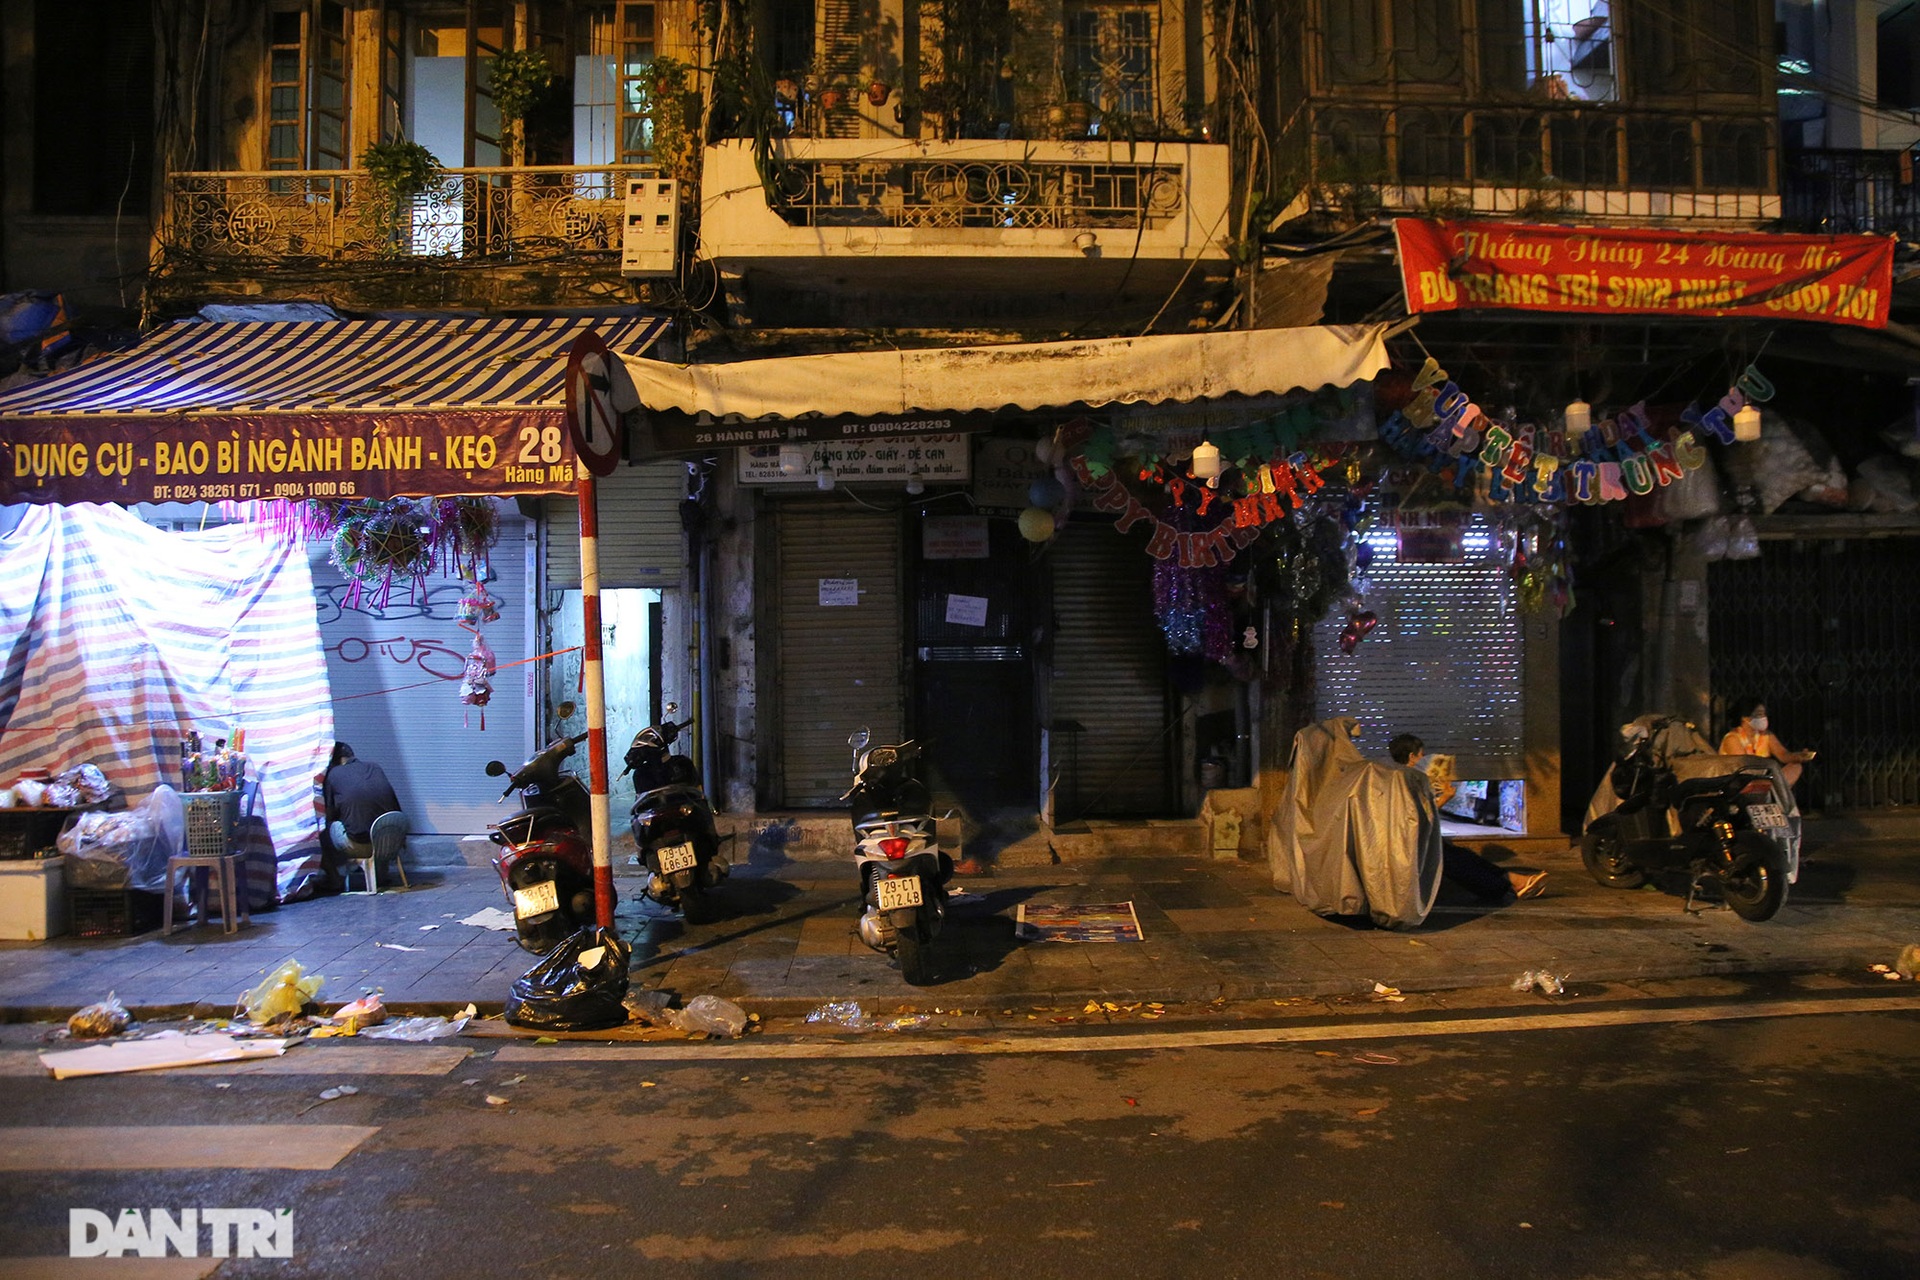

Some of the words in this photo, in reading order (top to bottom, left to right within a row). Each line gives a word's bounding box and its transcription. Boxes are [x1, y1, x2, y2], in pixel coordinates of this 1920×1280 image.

[1656, 242, 1689, 265] 24
[1703, 244, 1785, 274] Hàng
[1464, 273, 1550, 306] TRANG
[1607, 276, 1672, 309] SINH
[869, 419, 952, 433] 0904228293
[519, 427, 562, 463] 28
[696, 434, 712, 443] 26
[15, 442, 89, 487] DỤNG
[96, 442, 133, 487] CỤ
[155, 440, 209, 475] BAO
[217, 429, 240, 474] BÌ
[248, 428, 342, 473] NGÀNH
[350, 420, 421, 470] BÁNH
[445, 434, 497, 479] KẸO
[505, 465, 544, 483] Hàng
[549, 466, 574, 482] Mã
[154, 486, 171, 499] ĐT:
[175, 485, 197, 498] 024
[200, 484, 235, 498] 38261
[240, 483, 260, 497] 671
[274, 483, 304, 496] 0904
[308, 482, 336, 496] 1000
[339, 482, 356, 495] 66
[664, 854, 693, 872] 486.97
[885, 878, 914, 895] 29-C1
